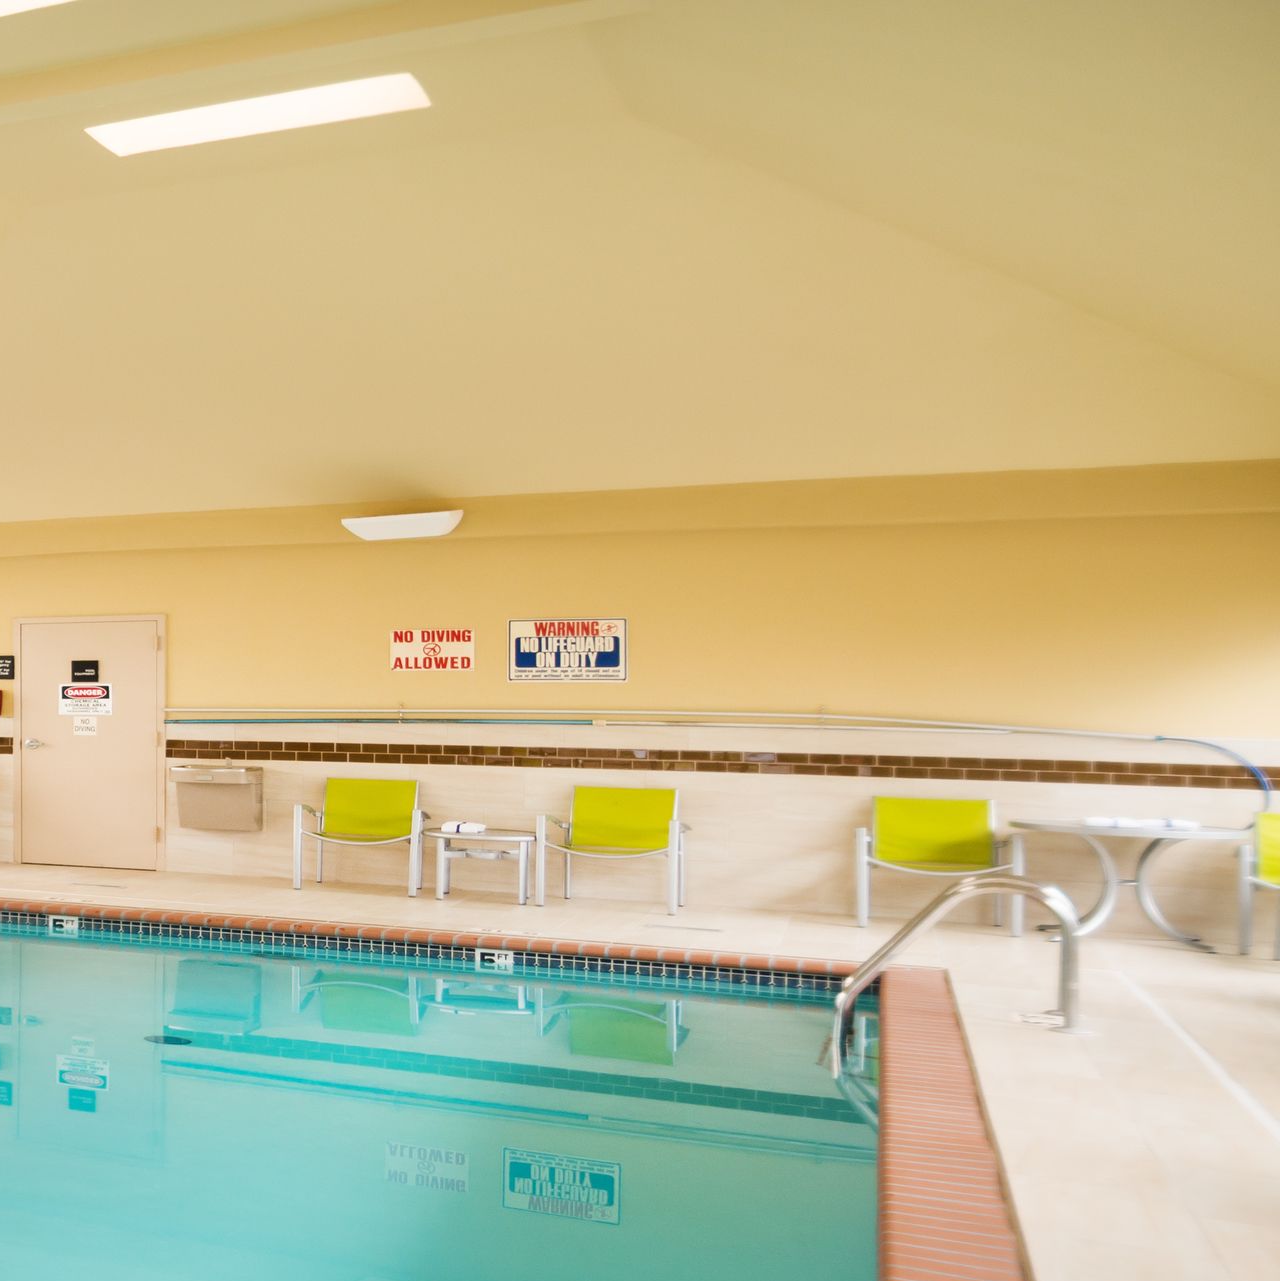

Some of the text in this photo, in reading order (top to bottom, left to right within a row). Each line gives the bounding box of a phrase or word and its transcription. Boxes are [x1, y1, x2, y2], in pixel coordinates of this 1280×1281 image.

[393, 629, 472, 643] NO DIVING
[534, 621, 600, 637] WARNING
[520, 636, 615, 653] NO LIFEGUARD
[393, 656, 471, 670] ALLOWED
[536, 651, 598, 668] ON DUTY
[497, 953, 509, 961] FT
